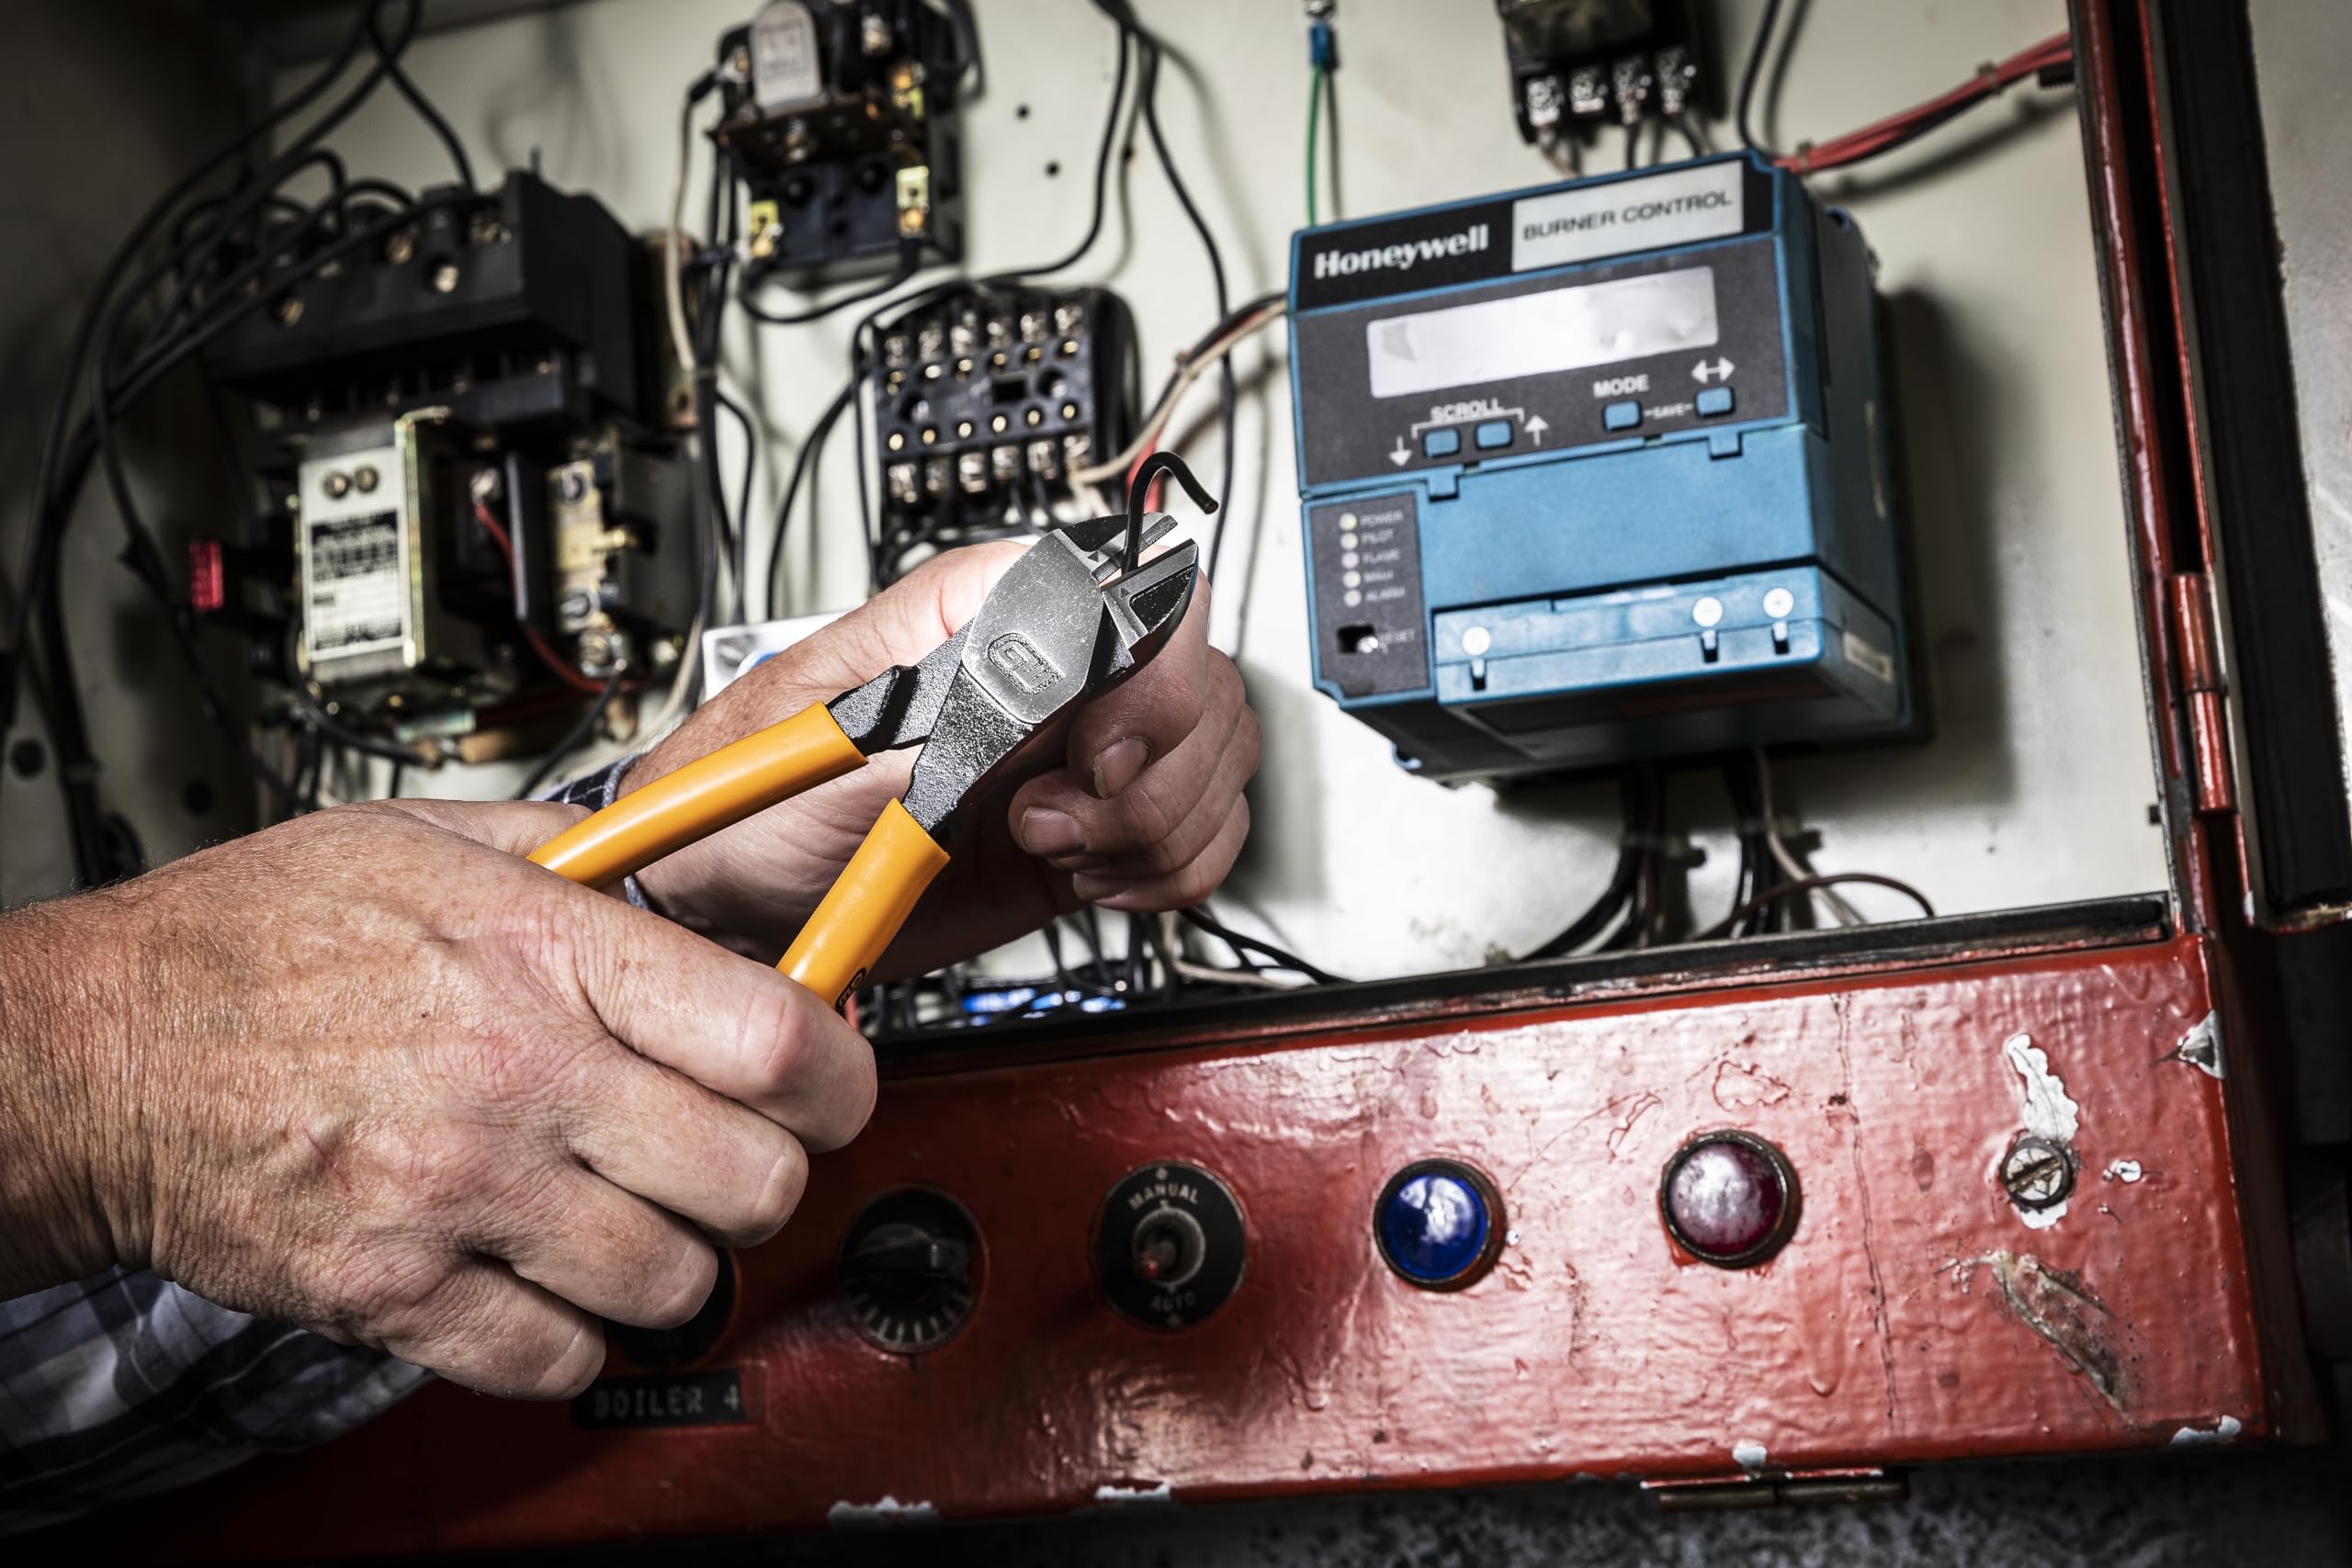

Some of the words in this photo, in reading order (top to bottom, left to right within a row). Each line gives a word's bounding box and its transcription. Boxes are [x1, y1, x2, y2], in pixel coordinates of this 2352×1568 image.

[1522, 209, 1617, 242] BURNER
[1622, 190, 1734, 223] CONTROL
[1314, 225, 1489, 278] Honeywell
[1593, 374, 1650, 399] MODE
[1430, 398, 1506, 423] SCROLL
[1360, 510, 1403, 526] POWER
[1128, 1182, 1198, 1210] MANUAL
[1150, 1291, 1196, 1312] AUTO
[595, 1384, 703, 1419] BOILER
[724, 1382, 740, 1411] 4
